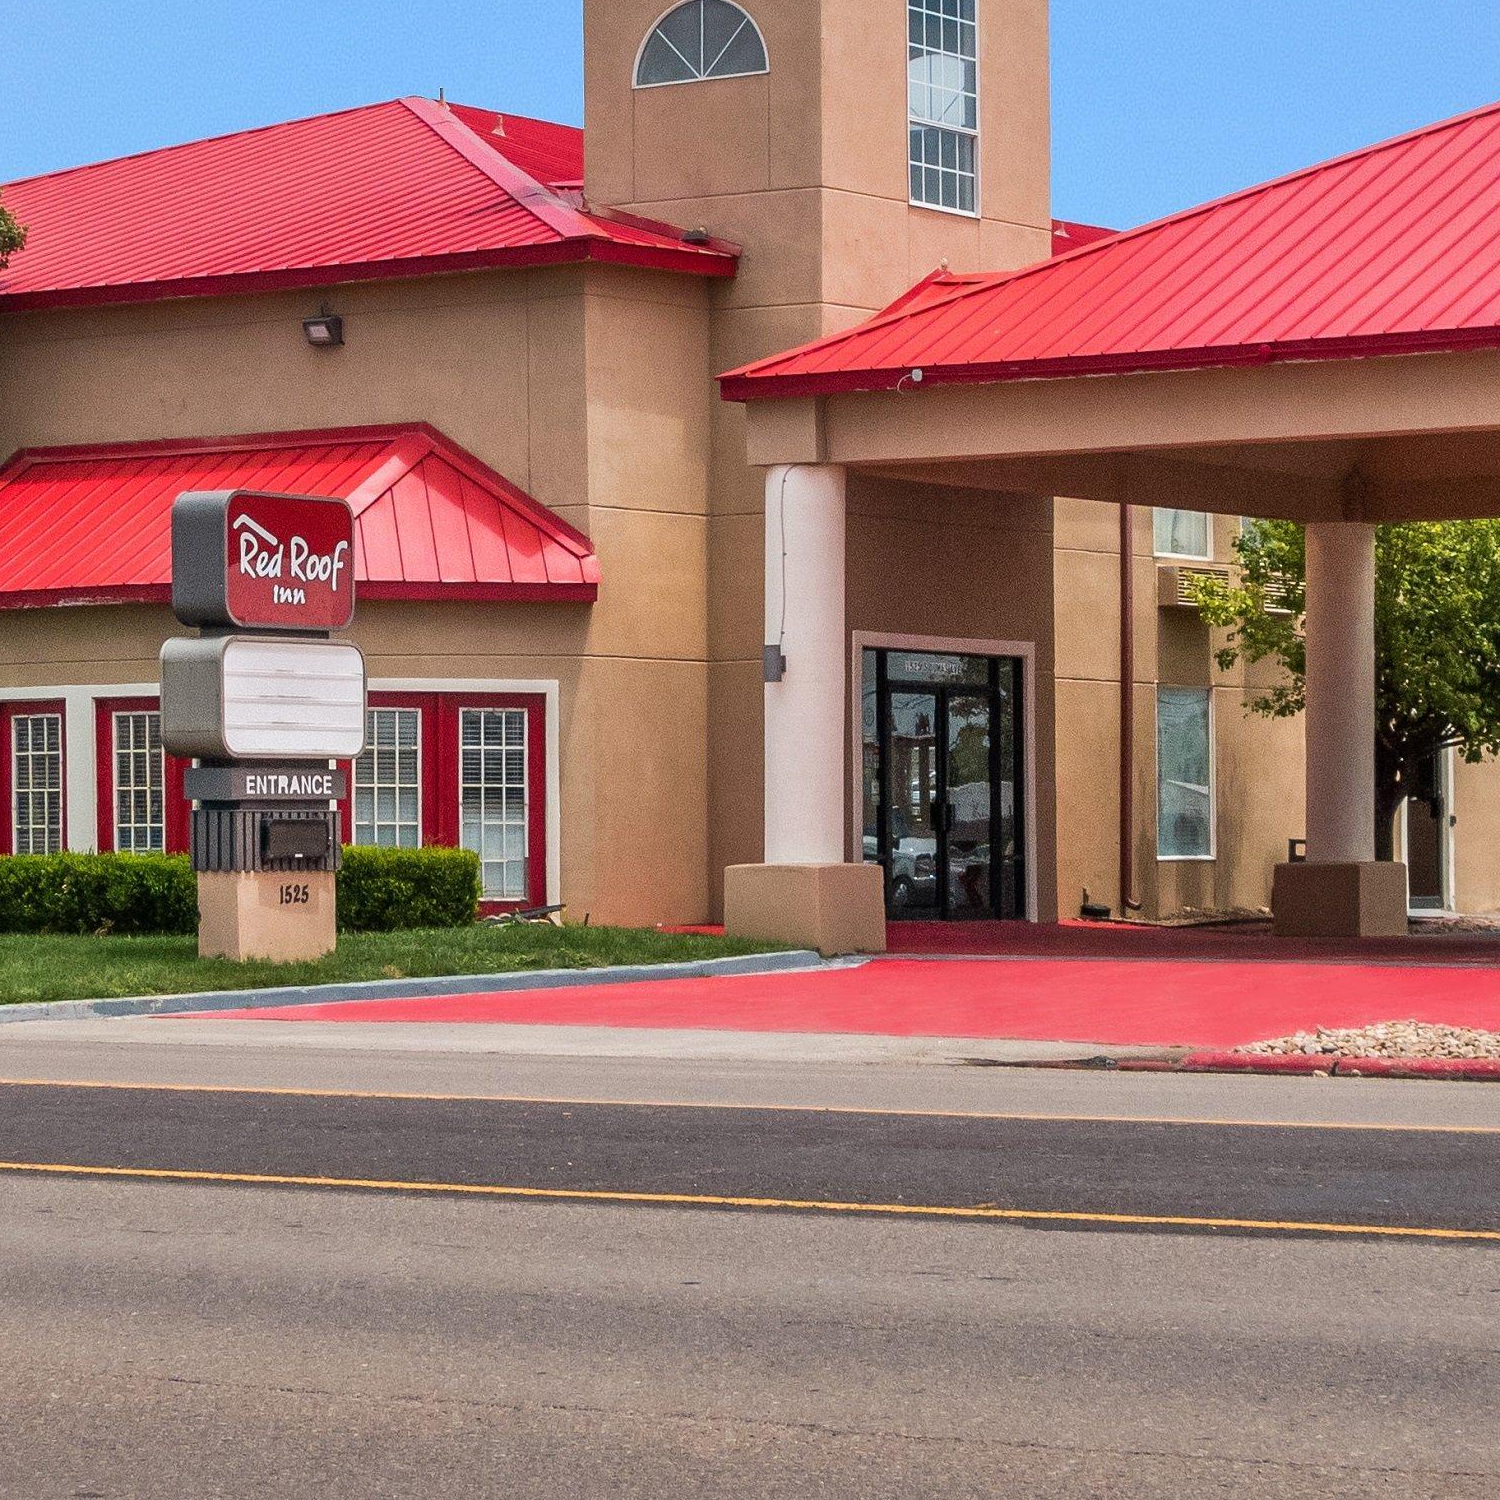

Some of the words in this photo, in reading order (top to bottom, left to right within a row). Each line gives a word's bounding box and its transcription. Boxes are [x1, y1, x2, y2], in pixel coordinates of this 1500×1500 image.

[240, 531, 284, 578] Red
[290, 535, 348, 592] Roof
[246, 775, 332, 795] ENTRANCE
[280, 884, 309, 905] 1525
